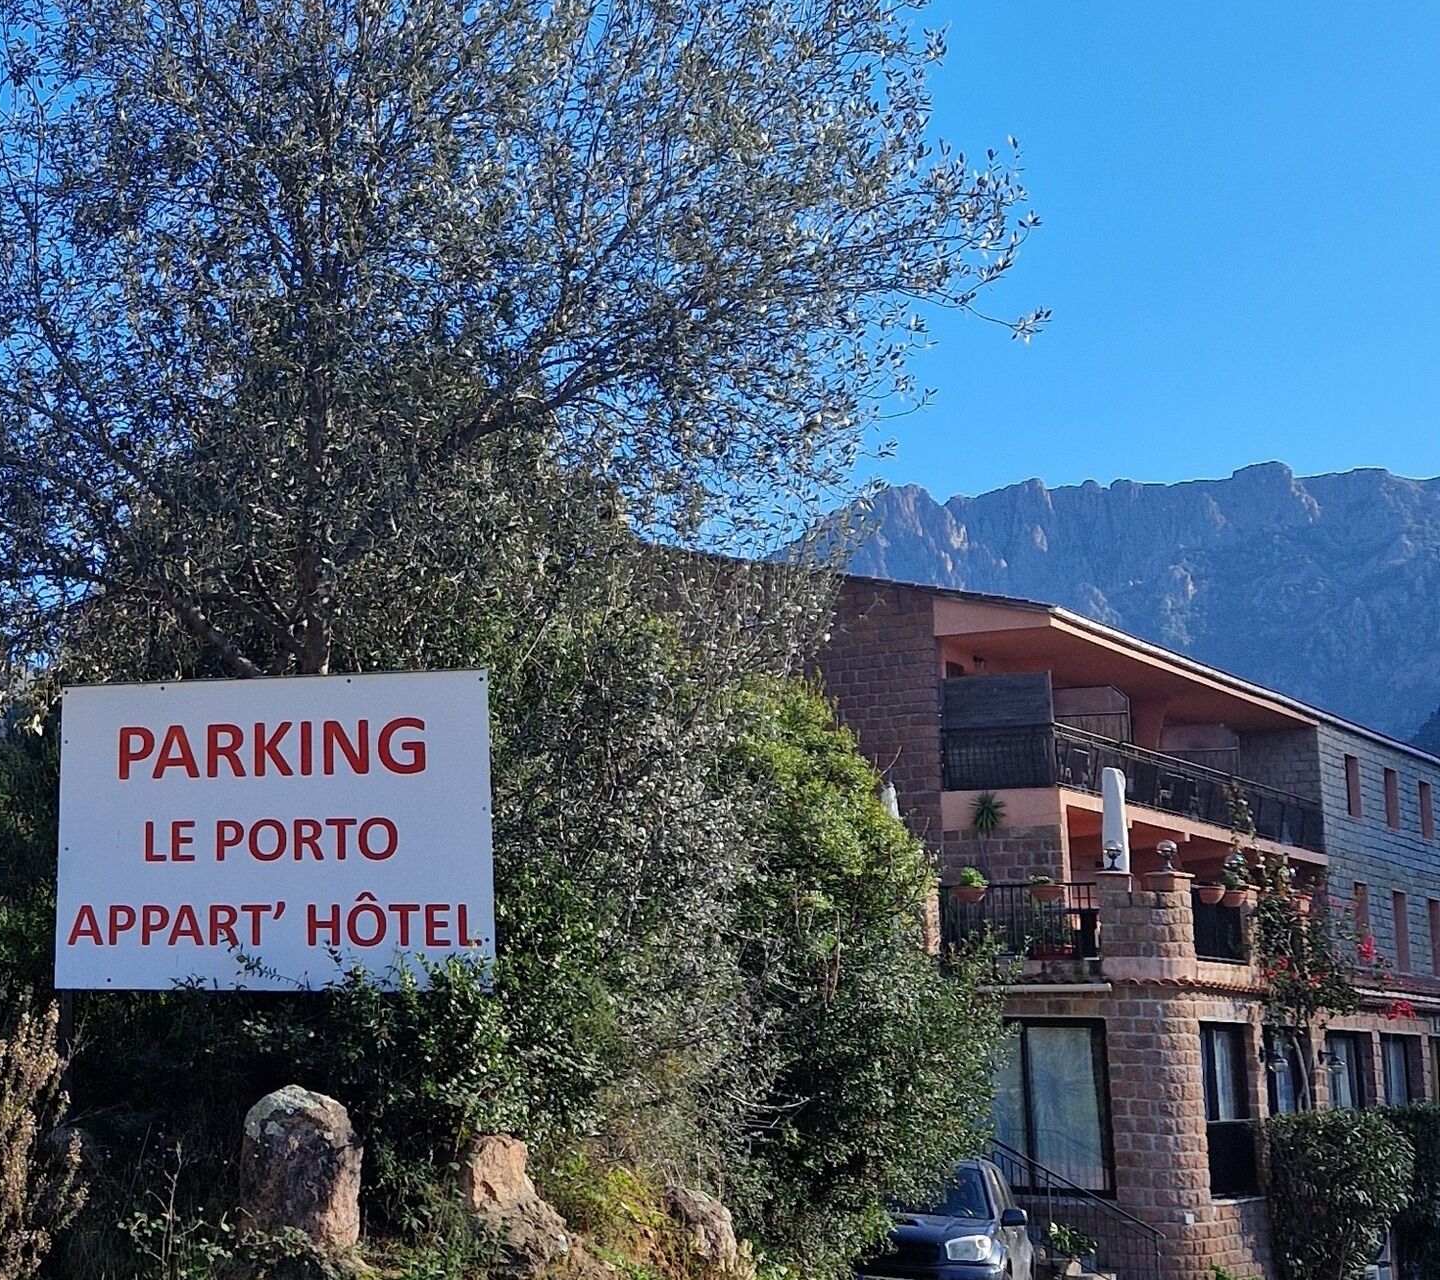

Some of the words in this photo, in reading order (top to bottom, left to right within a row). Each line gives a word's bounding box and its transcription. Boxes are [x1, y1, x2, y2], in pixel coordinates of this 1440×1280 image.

[117, 717, 427, 780] PARKING
[144, 821, 196, 862] LE
[215, 817, 399, 862] PORTO
[67, 901, 286, 947] APPART’
[307, 891, 483, 948] HÔTEL
